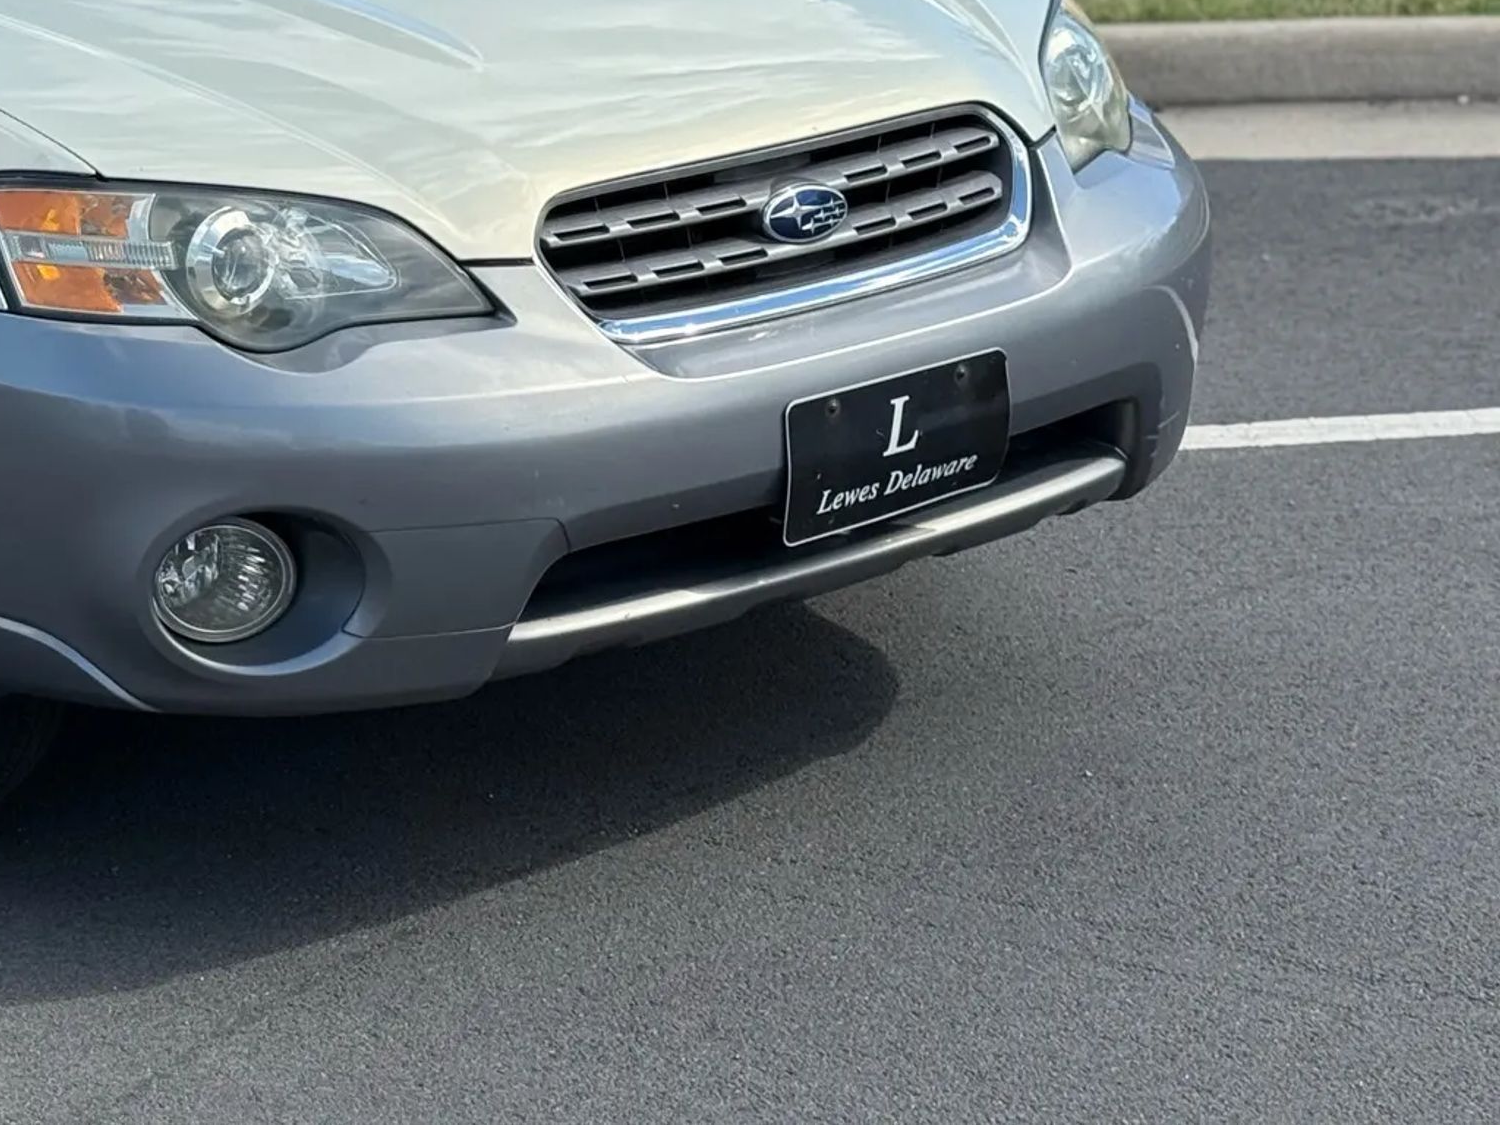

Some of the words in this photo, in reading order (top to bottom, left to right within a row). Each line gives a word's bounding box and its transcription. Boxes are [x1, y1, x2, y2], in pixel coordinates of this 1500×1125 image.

[883, 395, 919, 457] L
[816, 483, 880, 515] Lewes
[884, 454, 978, 496] Delaware
